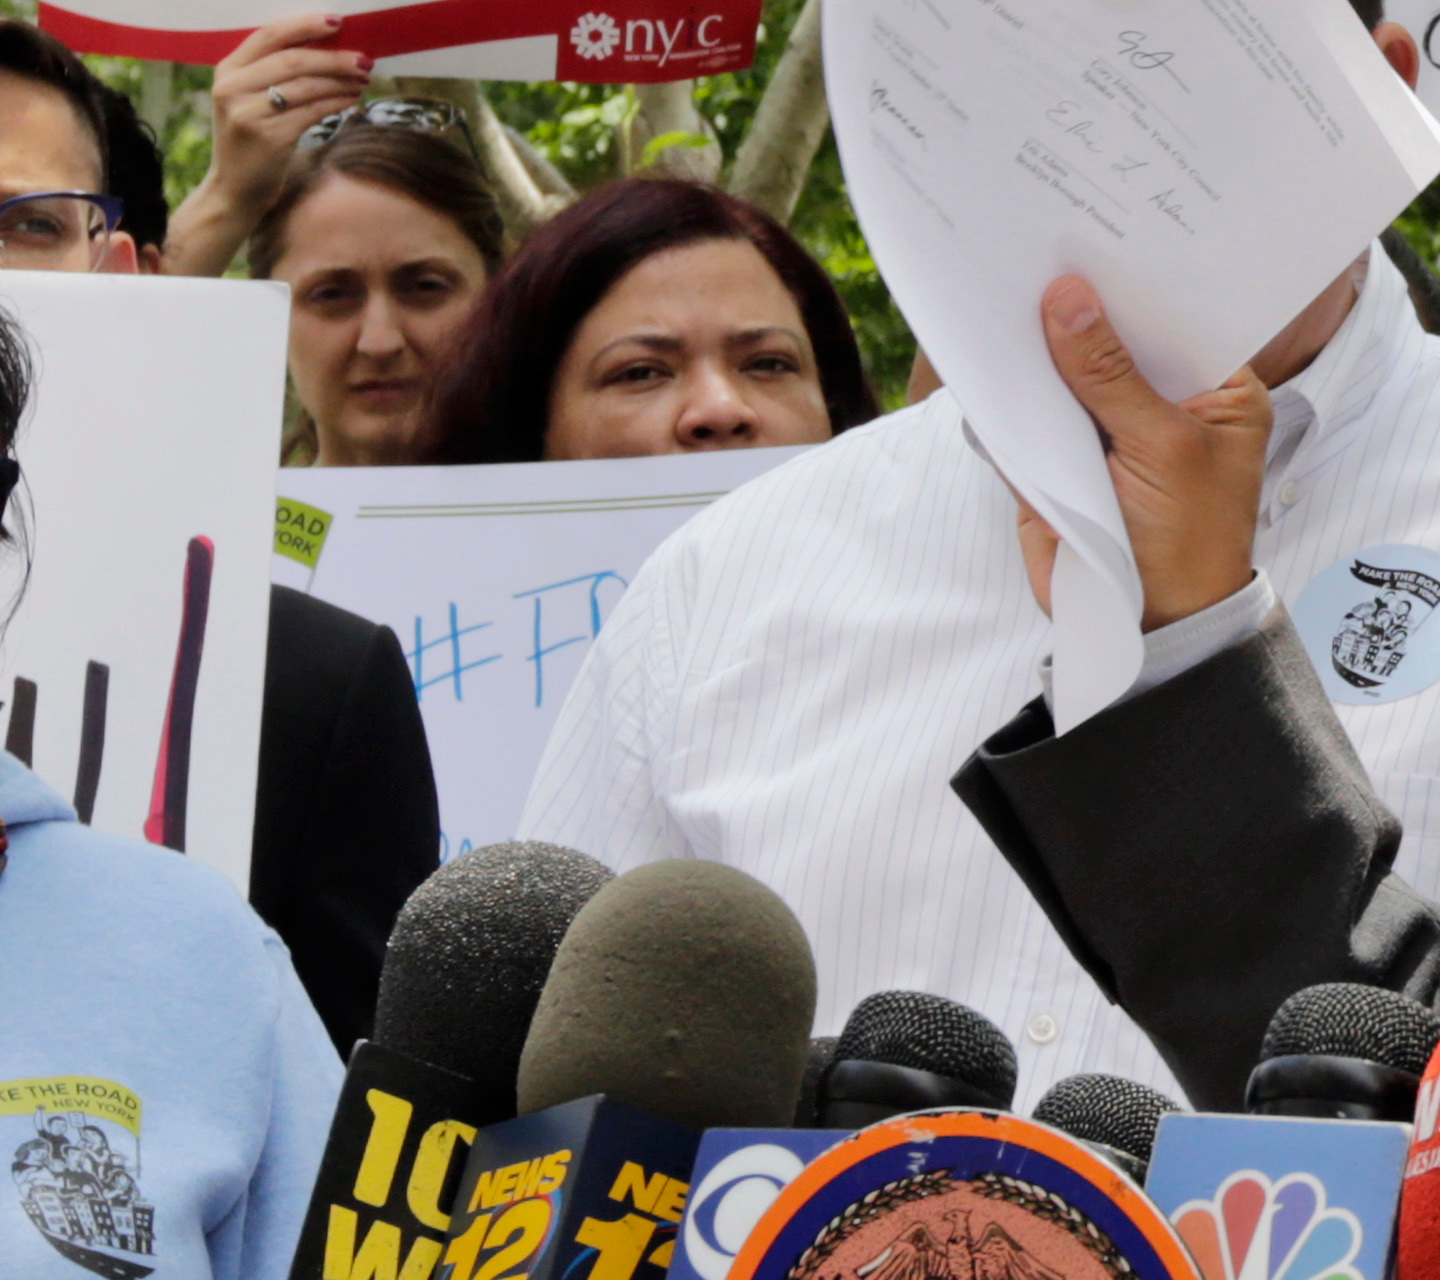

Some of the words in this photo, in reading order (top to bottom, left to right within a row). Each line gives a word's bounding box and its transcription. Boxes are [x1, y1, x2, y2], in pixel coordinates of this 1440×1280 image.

[274, 505, 326, 538] OAD
[1357, 566, 1391, 581] MAKE
[1392, 571, 1417, 583] THE
[1395, 581, 1421, 594] NEW
[1416, 587, 1440, 606] YORK
[24, 1081, 70, 1098] THE
[74, 1082, 139, 1111] ROAD
[52, 1097, 90, 1109] NEW
[95, 1100, 137, 1125] YORK
[467, 1148, 573, 1213] NEWS
[607, 1159, 690, 1222] NE
